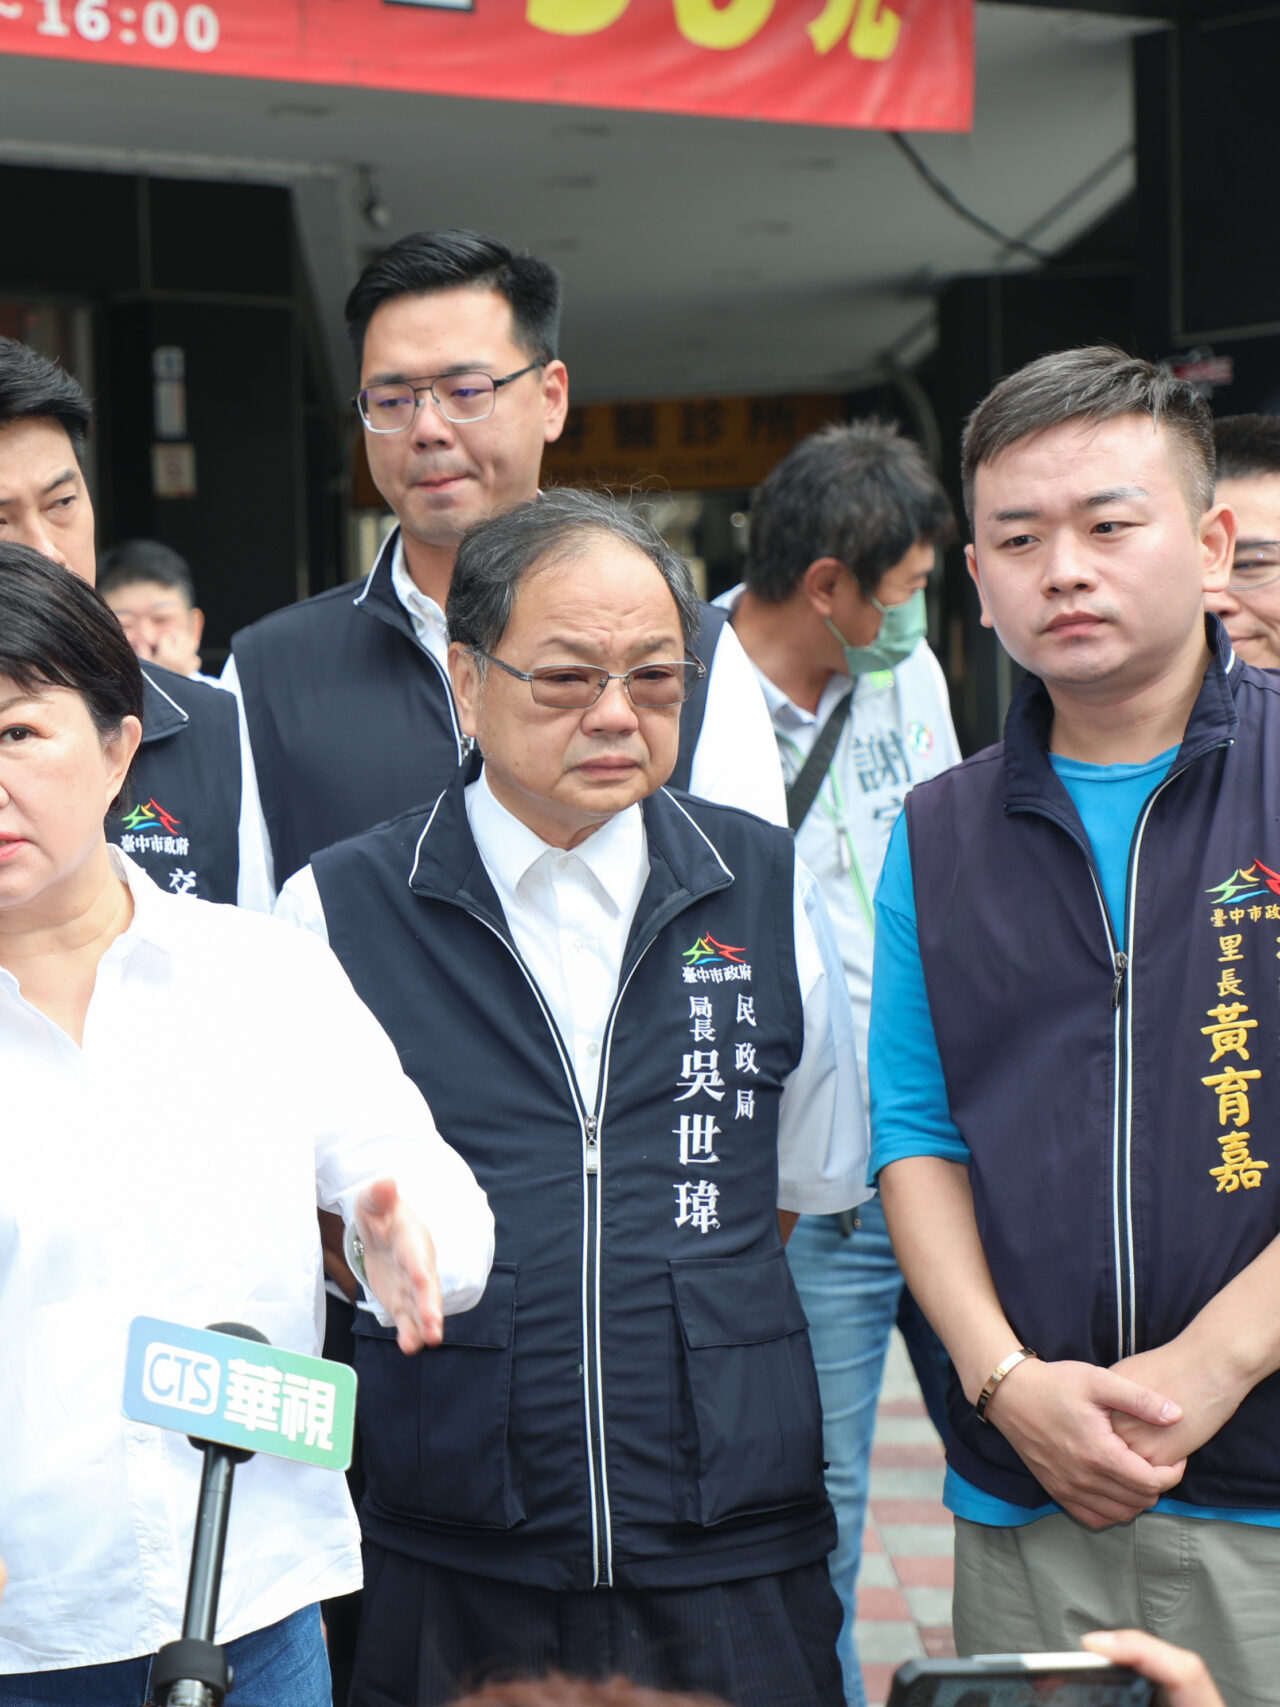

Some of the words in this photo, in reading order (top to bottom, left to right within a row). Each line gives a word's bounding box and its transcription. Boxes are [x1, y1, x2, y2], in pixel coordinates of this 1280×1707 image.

[120, 833, 190, 856] 臺中市政府
[681, 962, 753, 985] 臺中市政府
[734, 992, 760, 1121] 民政局
[148, 1352, 213, 1408] CTS
[223, 1357, 337, 1452] 華視
